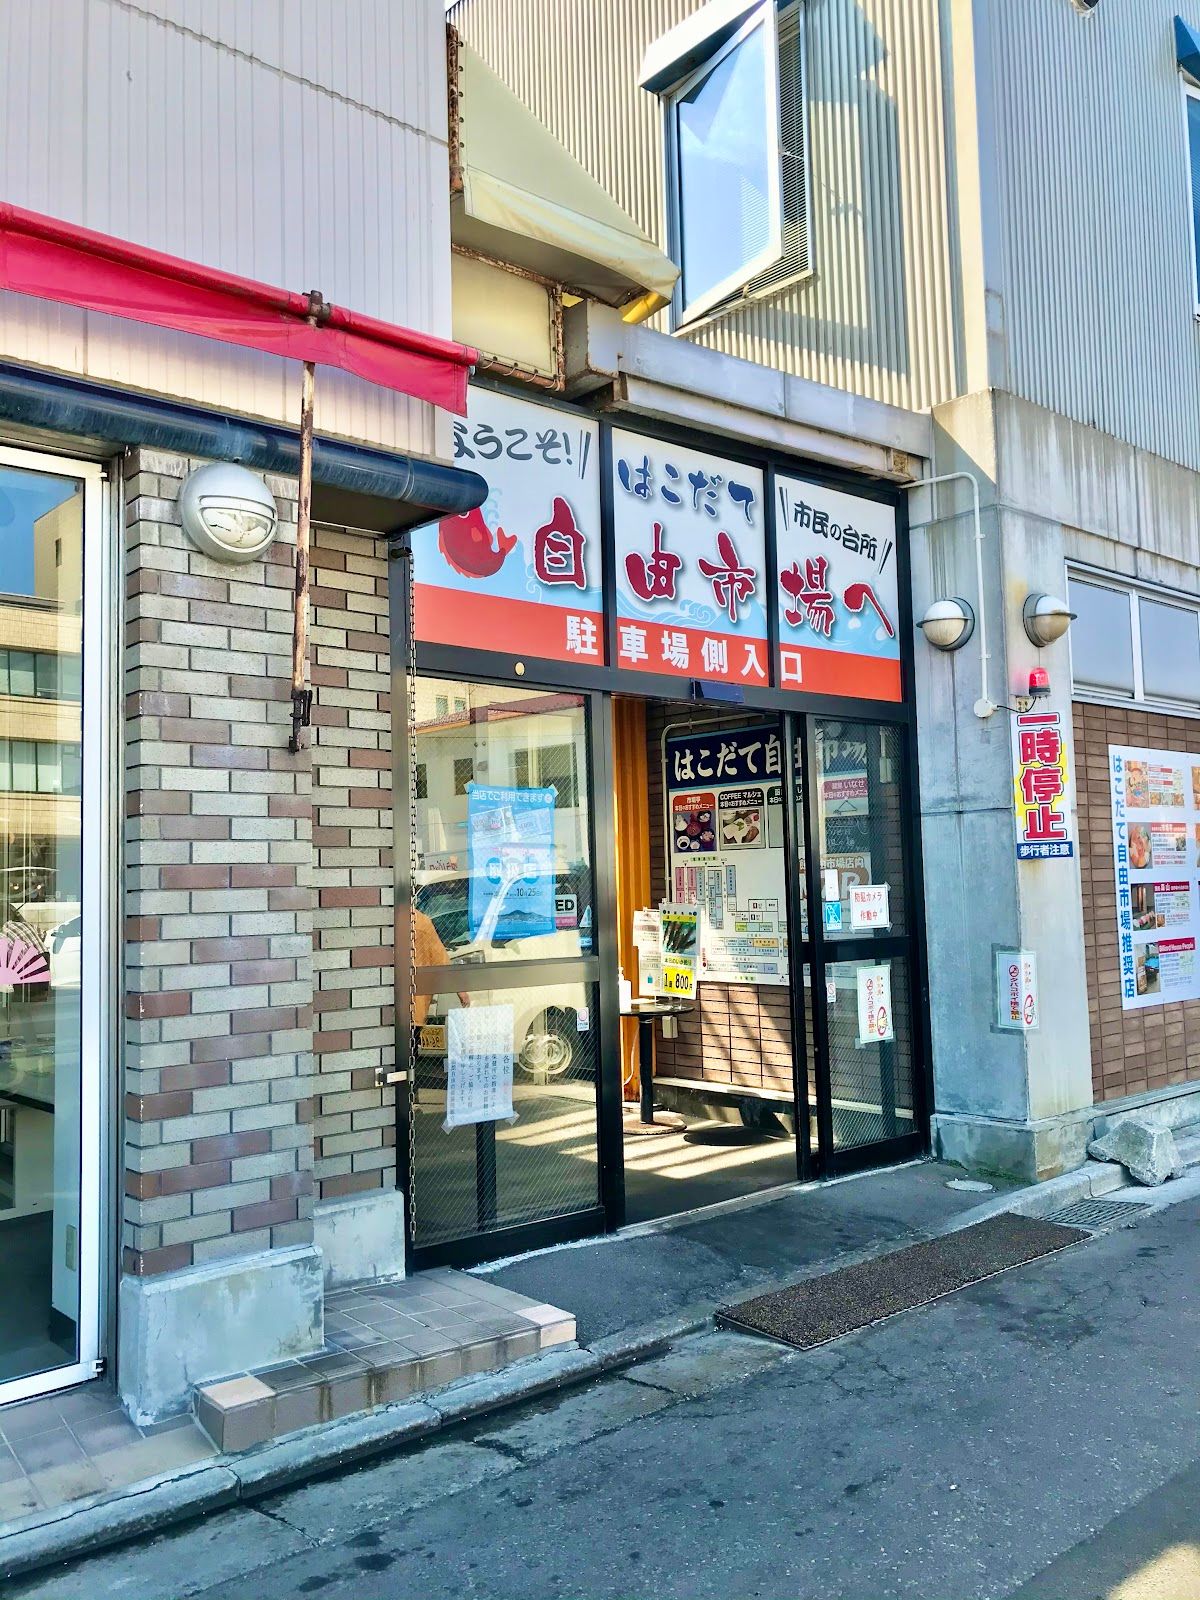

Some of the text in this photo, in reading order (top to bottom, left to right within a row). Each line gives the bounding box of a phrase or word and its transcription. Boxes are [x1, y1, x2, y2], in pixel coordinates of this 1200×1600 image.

[617, 454, 755, 524] はこだて
[793, 500, 879, 562] 市民の台所
[566, 614, 804, 684] 駐車場側入口
[1017, 711, 1068, 841] 一時停止
[1019, 842, 1071, 858] 歩行者注意
